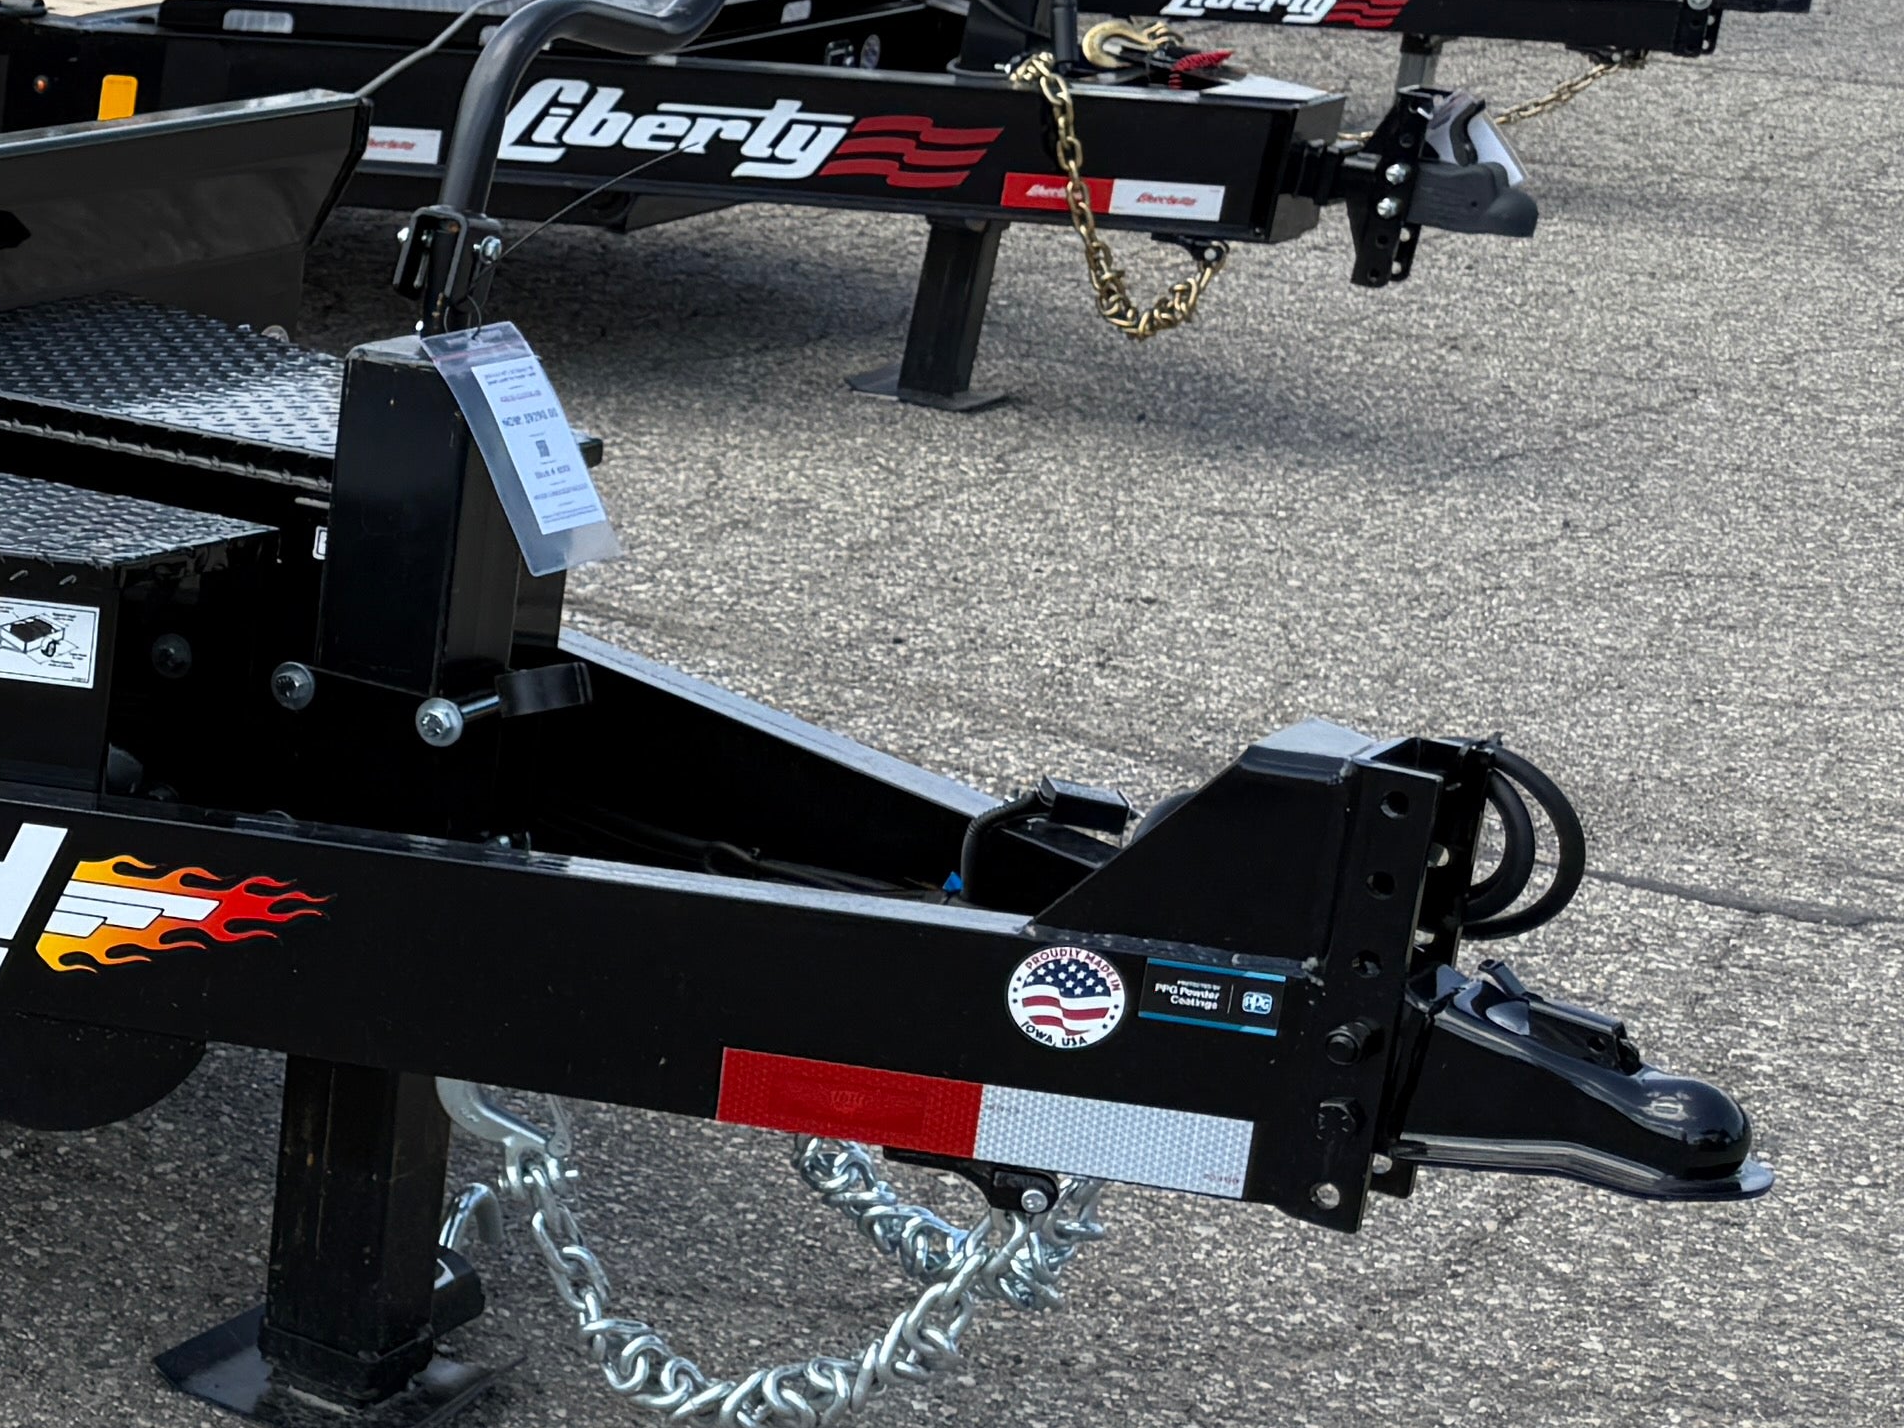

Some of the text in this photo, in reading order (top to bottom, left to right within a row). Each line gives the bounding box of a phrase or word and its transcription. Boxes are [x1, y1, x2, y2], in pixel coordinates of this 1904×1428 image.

[497, 78, 856, 179] Liberty
[1025, 948, 1082, 970] PROUDLY
[1085, 954, 1115, 978] MADE
[1061, 1036, 1088, 1047] USA
